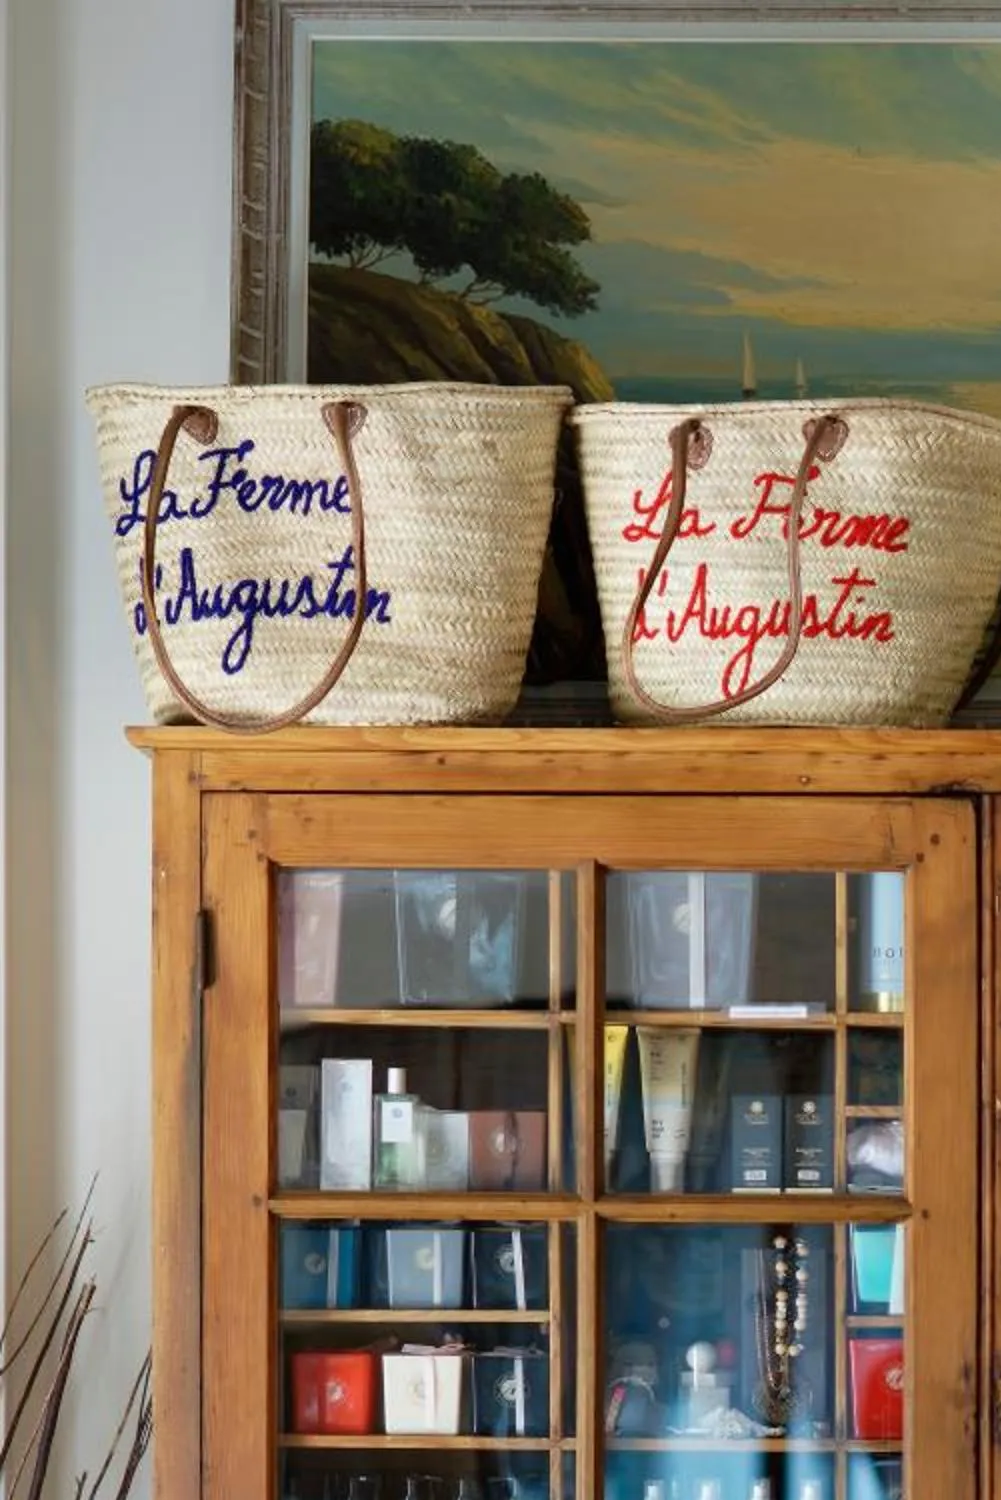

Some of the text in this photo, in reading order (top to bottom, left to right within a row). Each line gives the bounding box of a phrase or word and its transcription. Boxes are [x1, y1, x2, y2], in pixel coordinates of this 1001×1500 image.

[114, 439, 353, 537] La Ferme
[621, 470, 717, 543] La
